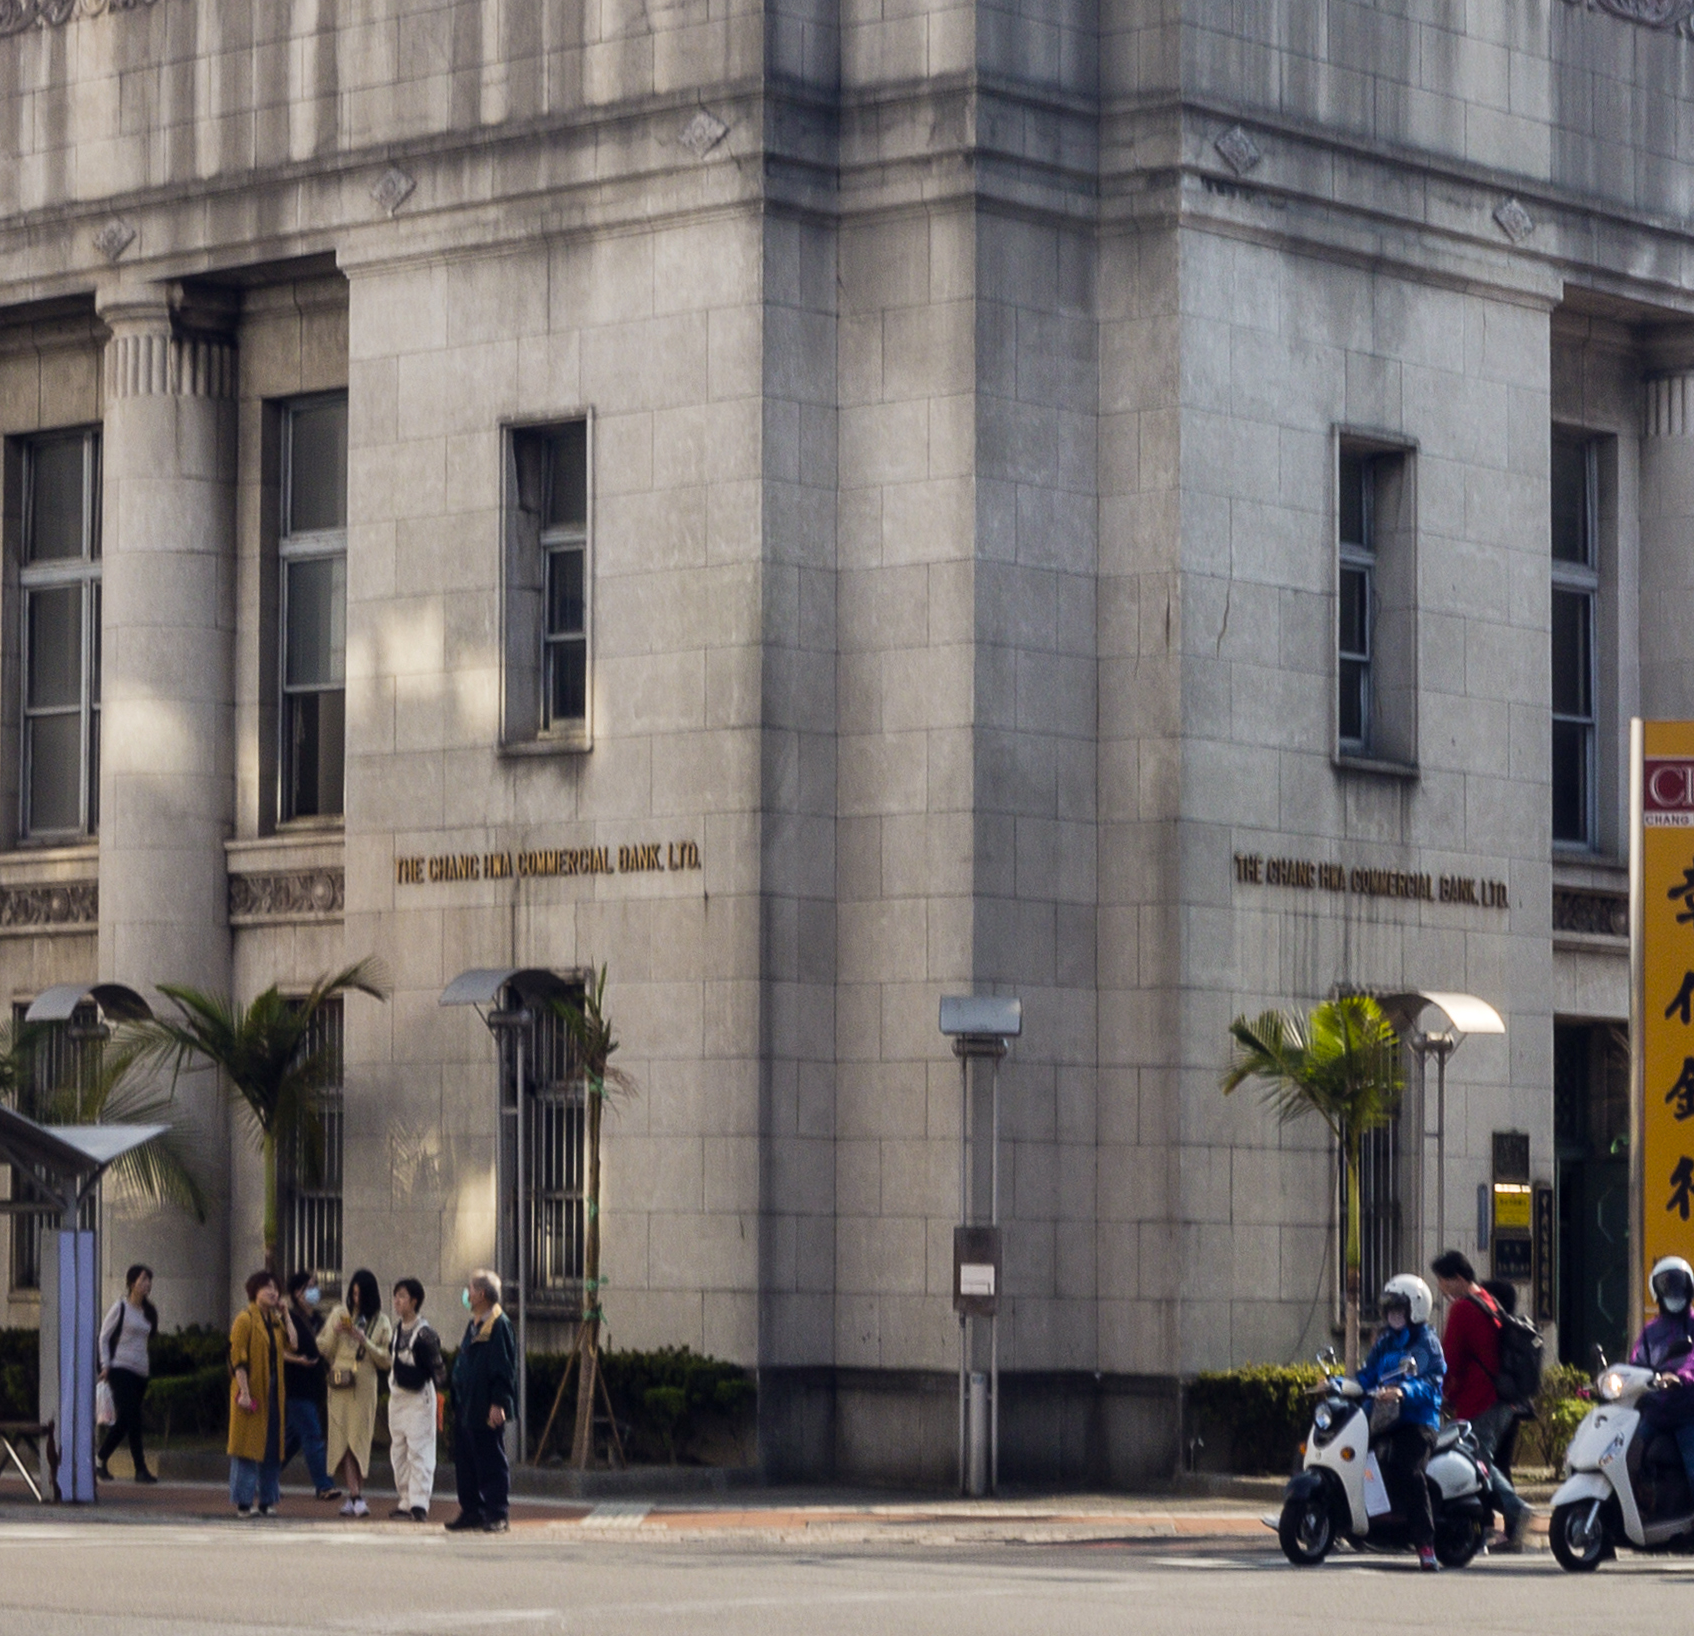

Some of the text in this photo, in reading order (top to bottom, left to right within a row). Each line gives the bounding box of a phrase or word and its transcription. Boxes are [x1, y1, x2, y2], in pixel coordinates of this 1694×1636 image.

[1646, 815, 1690, 826] CHANG
[396, 855, 426, 885] THE
[427, 853, 480, 883] CHANG
[483, 852, 514, 880] HWA
[516, 845, 614, 878] COMMERCIAL
[1234, 851, 1263, 885] THE
[1266, 855, 1316, 889] CHANG
[1318, 860, 1347, 893] HWA
[1350, 865, 1436, 902] COMMERCIAL
